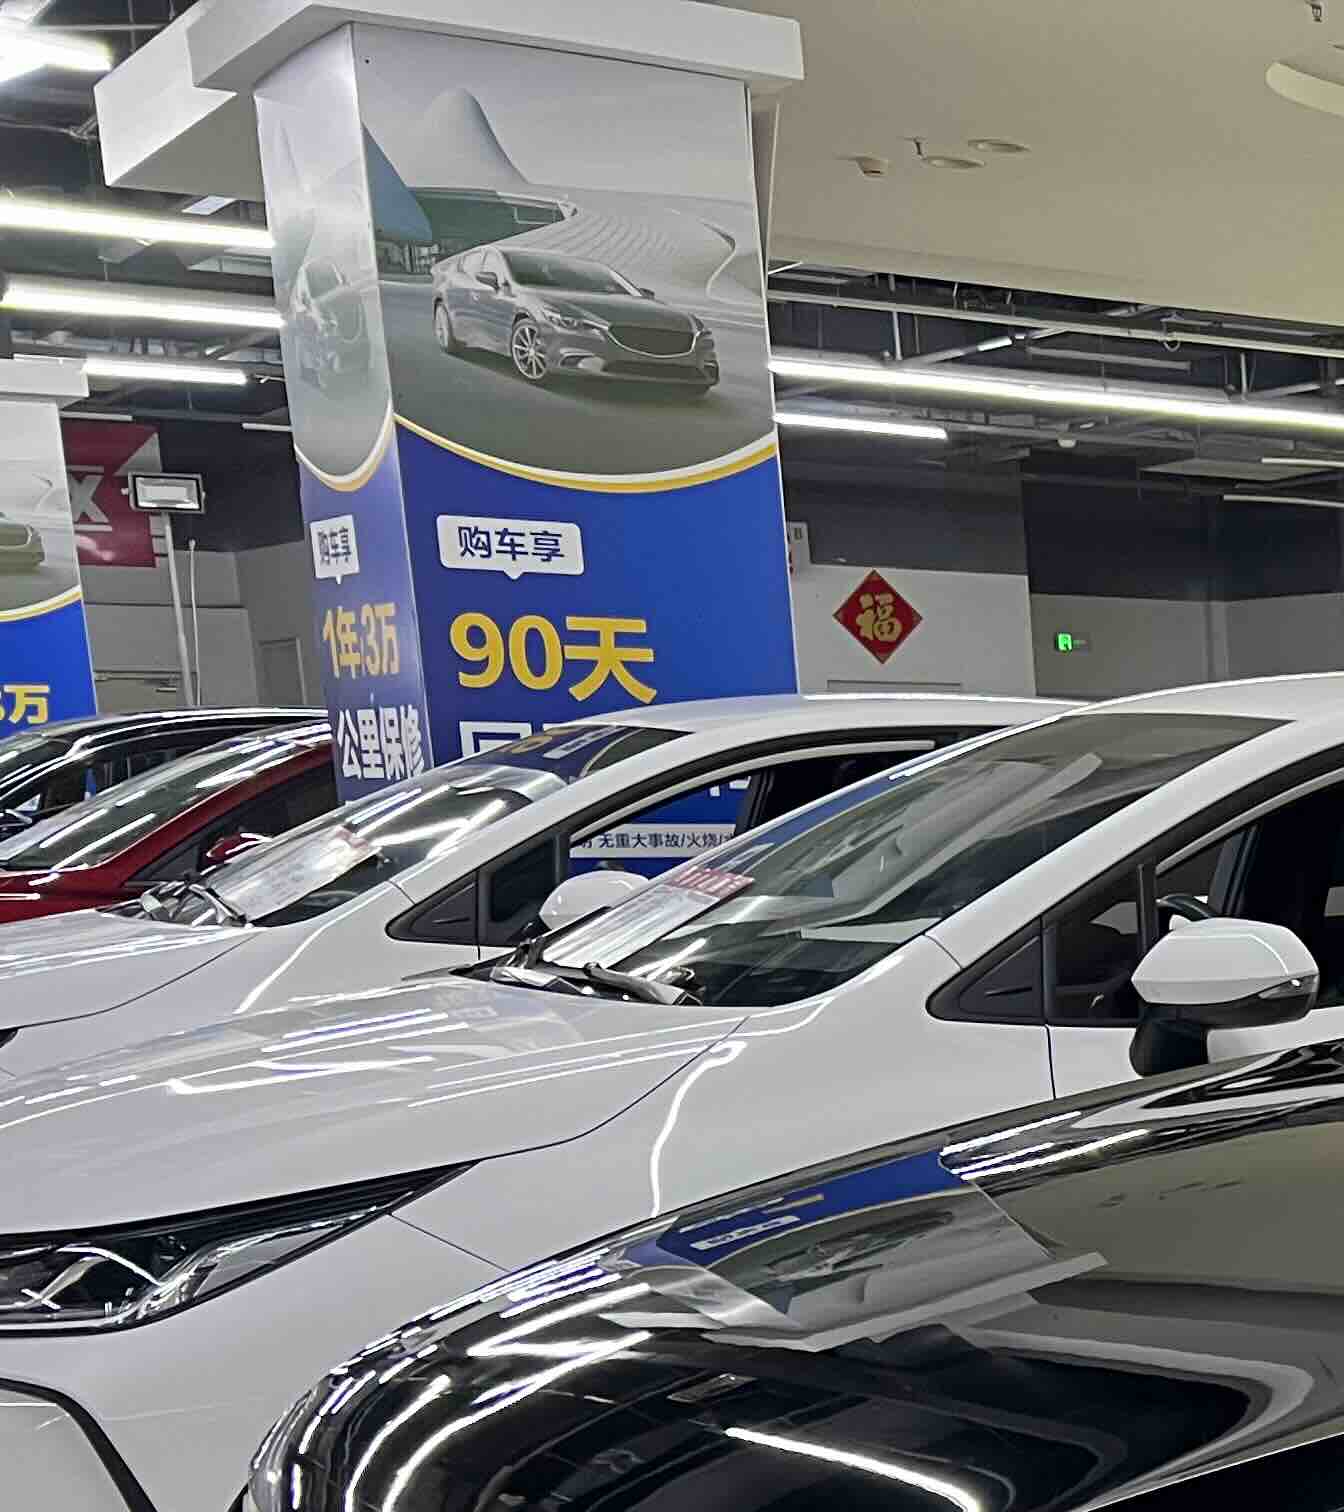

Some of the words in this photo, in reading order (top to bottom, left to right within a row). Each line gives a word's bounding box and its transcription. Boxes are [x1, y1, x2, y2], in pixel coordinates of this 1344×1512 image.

[457, 525, 566, 563] 购车享
[449, 611, 658, 705] 90天
[0, 684, 50, 725] 万
[337, 704, 426, 780] 公里保修
